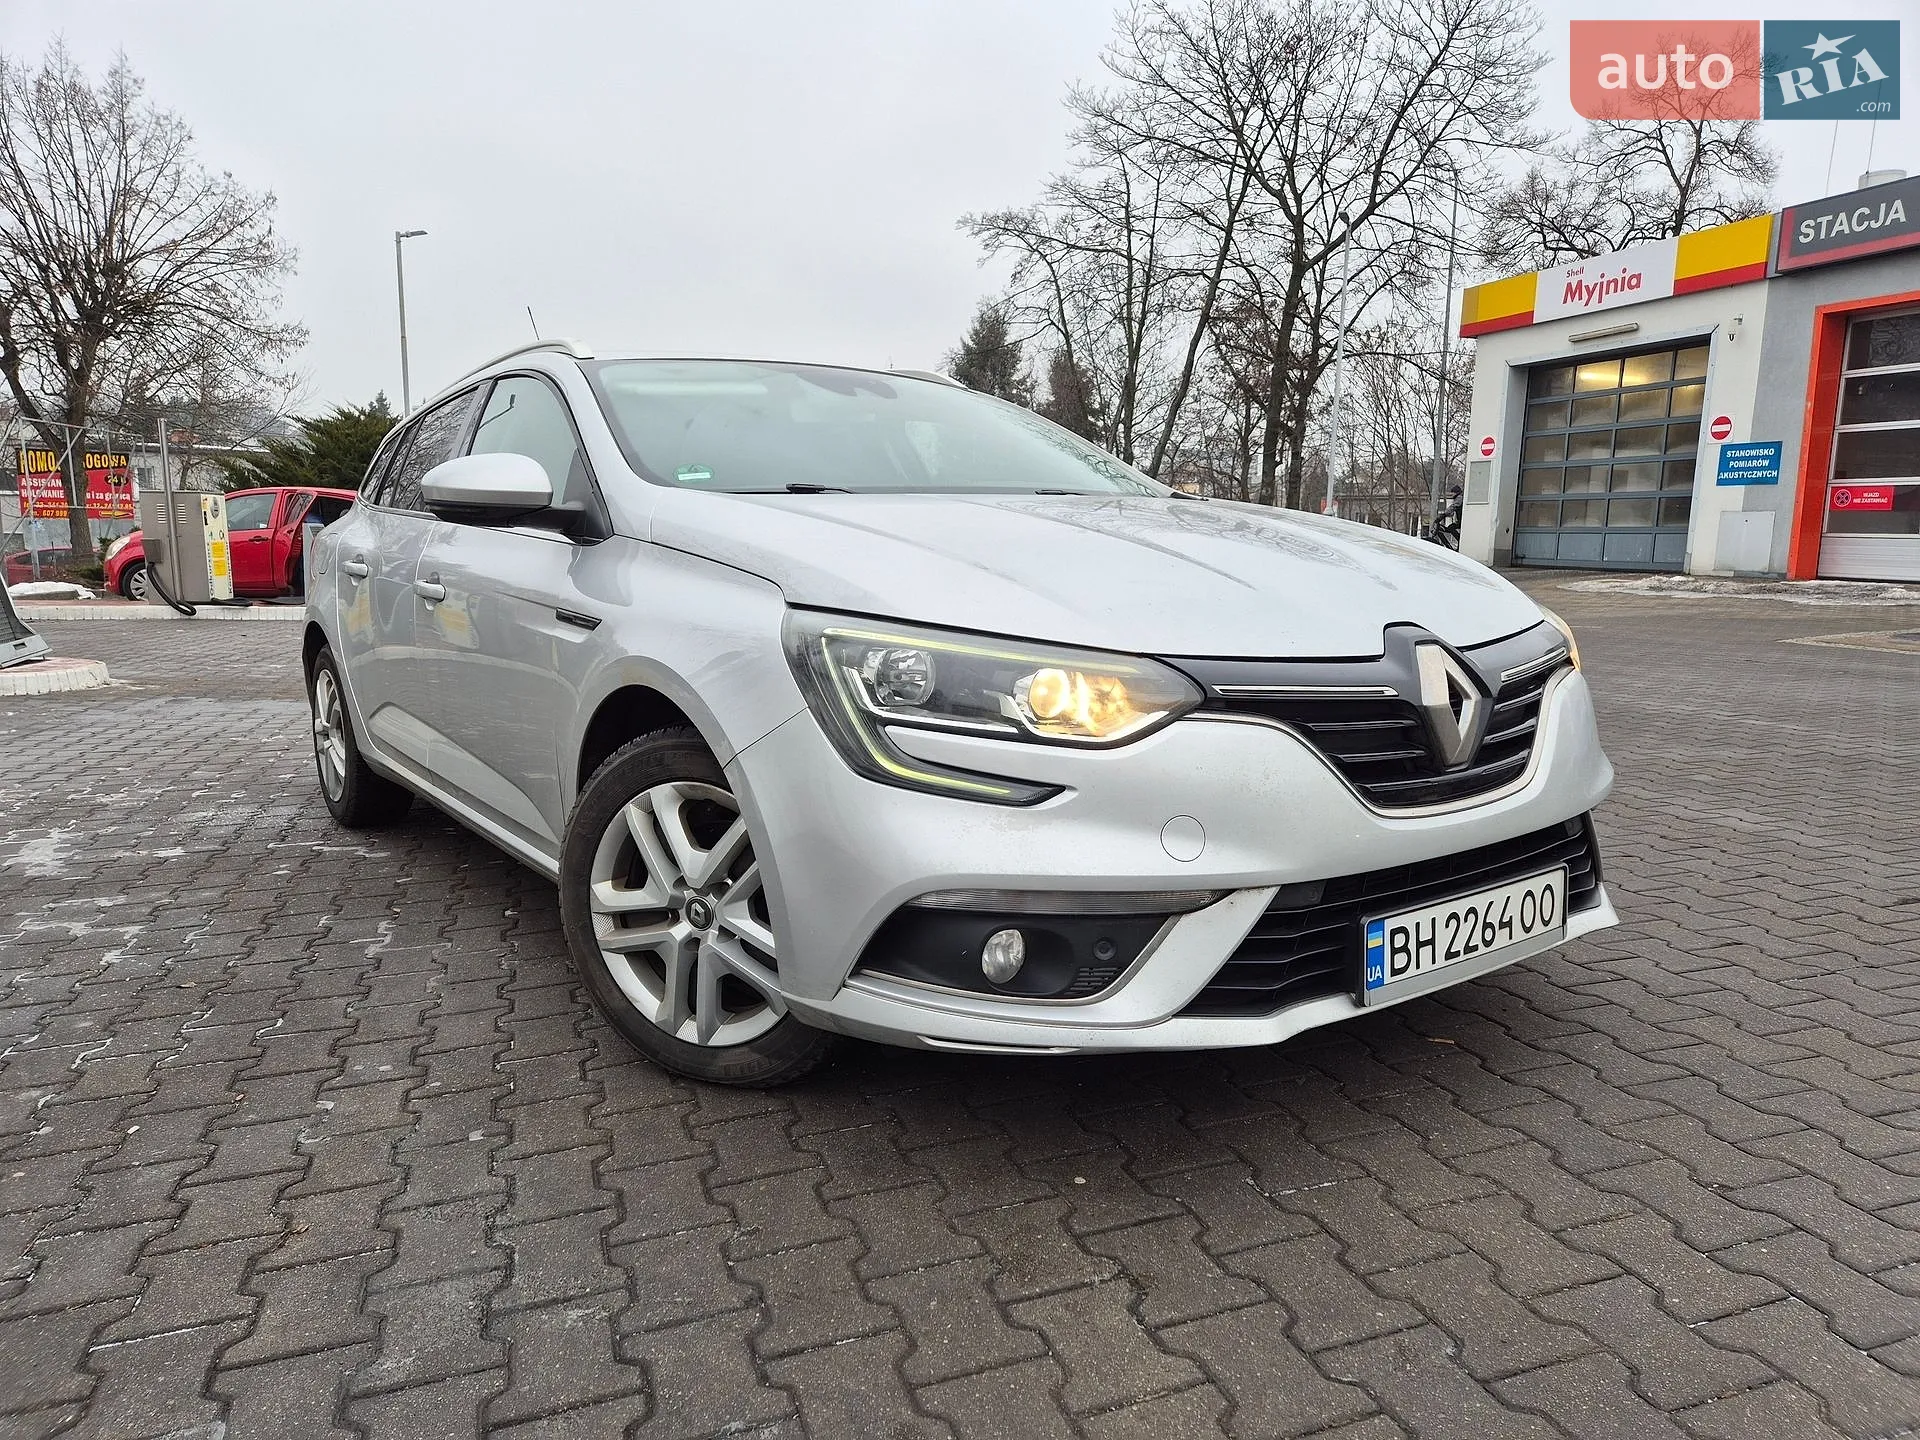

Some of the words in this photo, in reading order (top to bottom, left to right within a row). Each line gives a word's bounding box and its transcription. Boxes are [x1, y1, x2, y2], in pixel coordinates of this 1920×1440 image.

[1798, 199, 1907, 244] STACJA
[1566, 266, 1584, 279] Shell
[1562, 267, 1642, 307] Myjnia
[1726, 448, 1775, 458] STANOWISKO
[20, 450, 61, 474] POMO
[83, 453, 127, 469] OGOWA
[1728, 457, 1770, 469] POMIARÓW
[1718, 469, 1778, 480] AKUSTYCZNYCH
[21, 477, 62, 488] ASSISTAN
[1389, 916, 1437, 978] BH
[1443, 895, 1514, 962] 2264
[1367, 964, 1383, 982] UA
